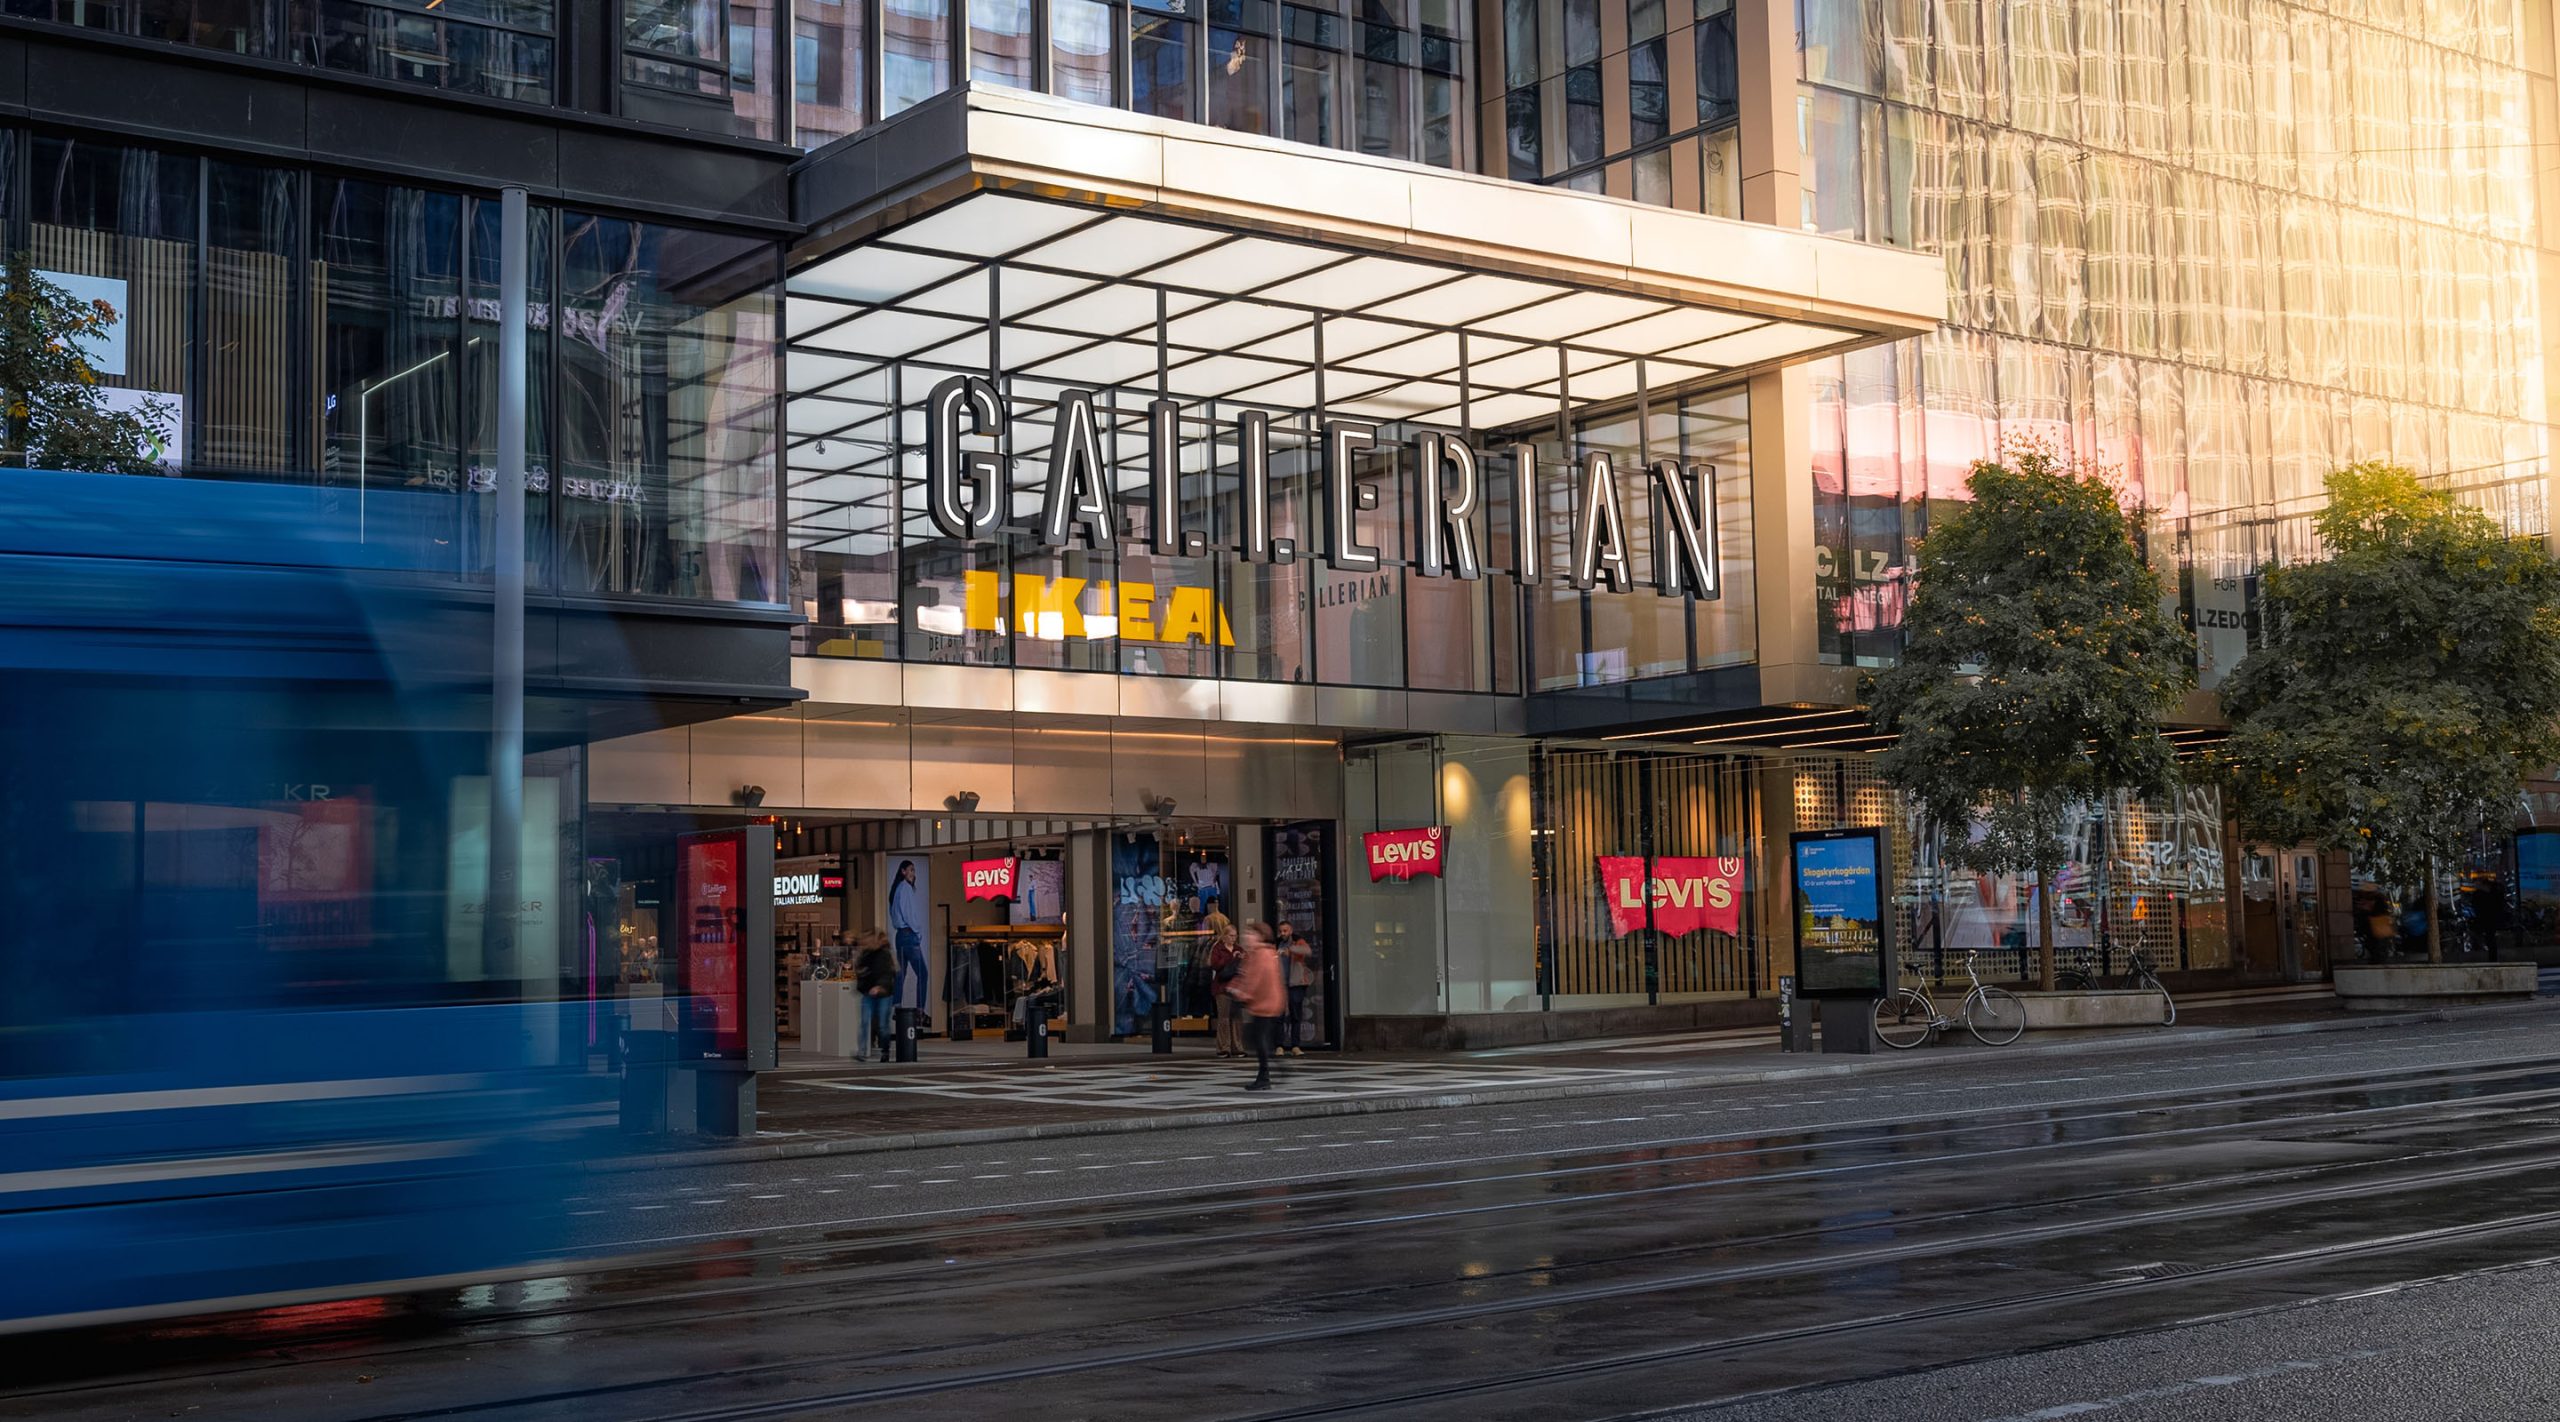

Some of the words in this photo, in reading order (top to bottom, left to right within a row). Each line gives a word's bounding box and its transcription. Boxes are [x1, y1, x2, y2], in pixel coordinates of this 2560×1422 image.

[327, 394, 337, 410] LG
[926, 374, 1720, 600] GALLERIAN
[2214, 578, 2237, 592] FOR
[1299, 575, 1389, 611] GLLERIAN
[965, 570, 1235, 647] IKEA
[907, 1026, 915, 1040] G
[1038, 1023, 1047, 1037] G
[1163, 1020, 1171, 1032] G
